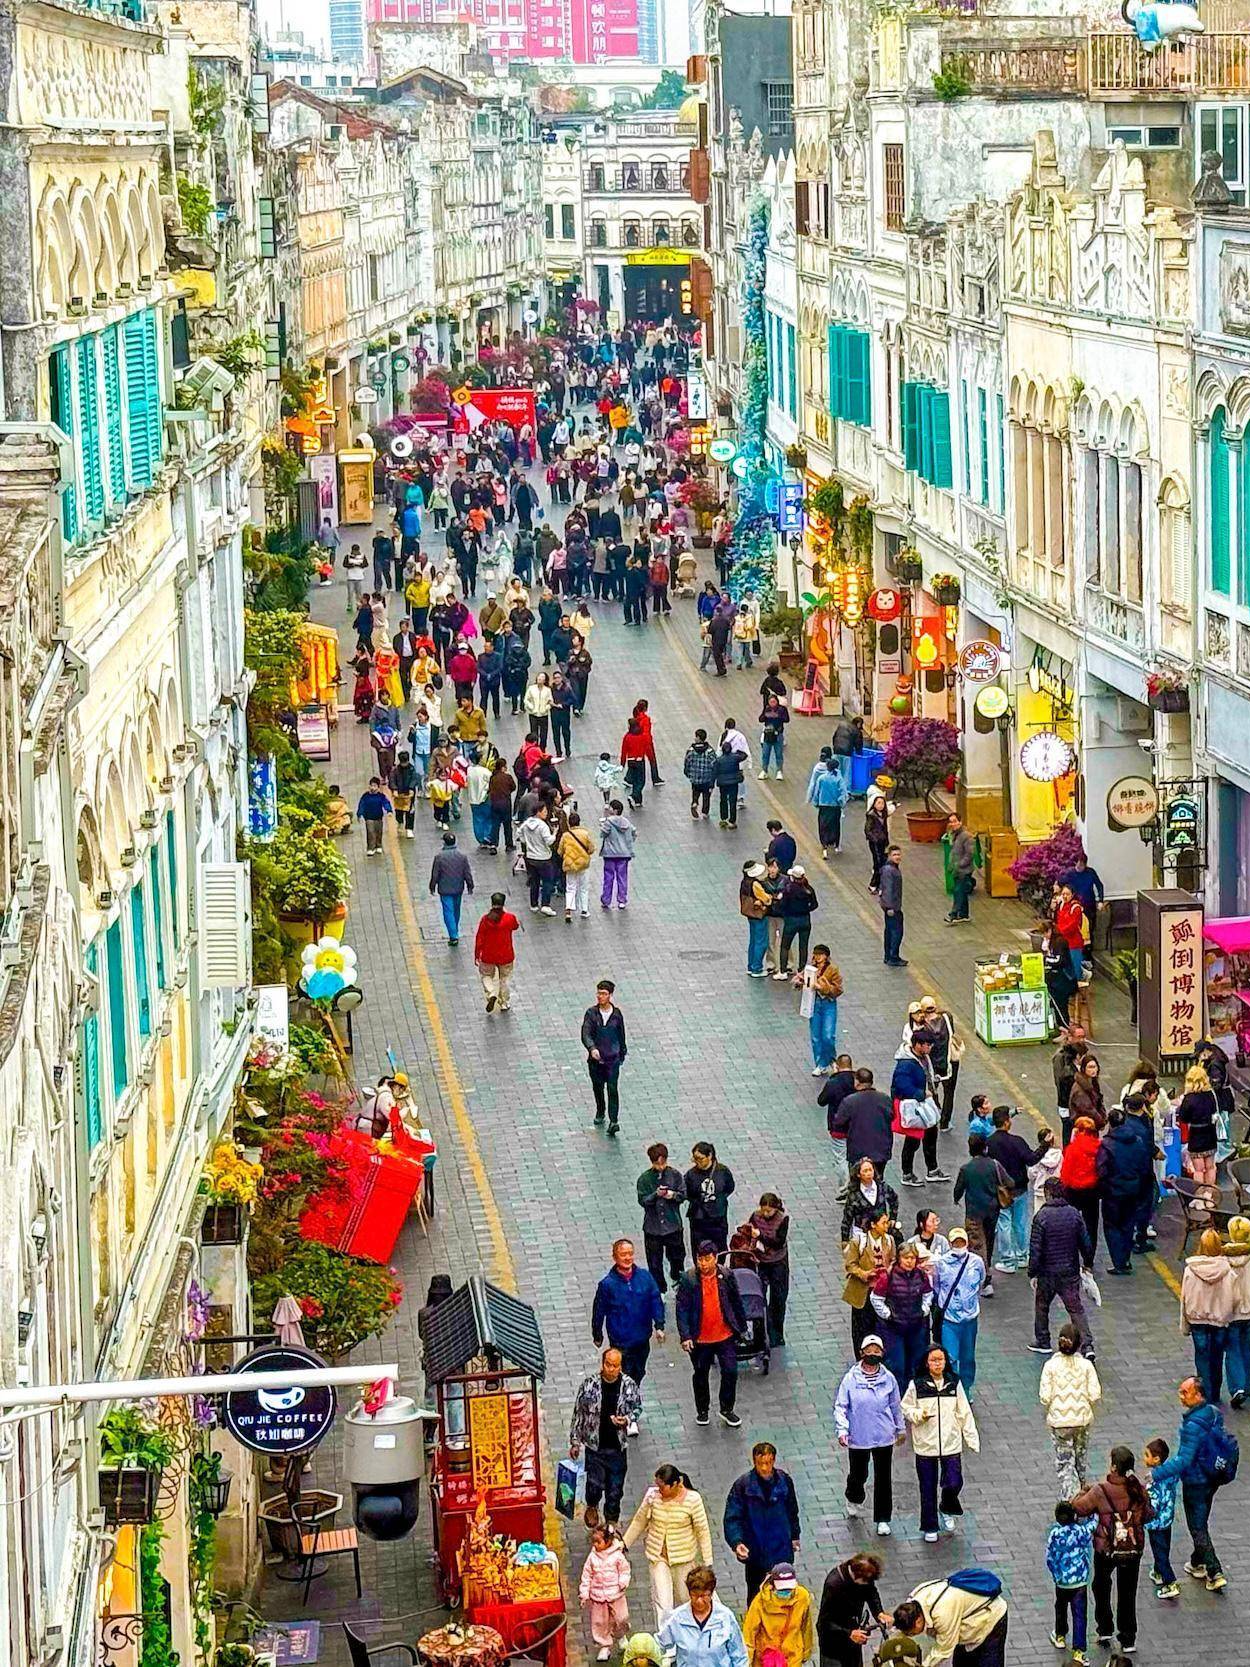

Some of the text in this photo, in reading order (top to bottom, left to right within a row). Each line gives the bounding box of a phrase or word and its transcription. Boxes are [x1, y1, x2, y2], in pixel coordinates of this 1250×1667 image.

[1169, 918, 1196, 1047] 颠倒博物馆
[237, 1413, 323, 1426] QIU JIE COFFEE
